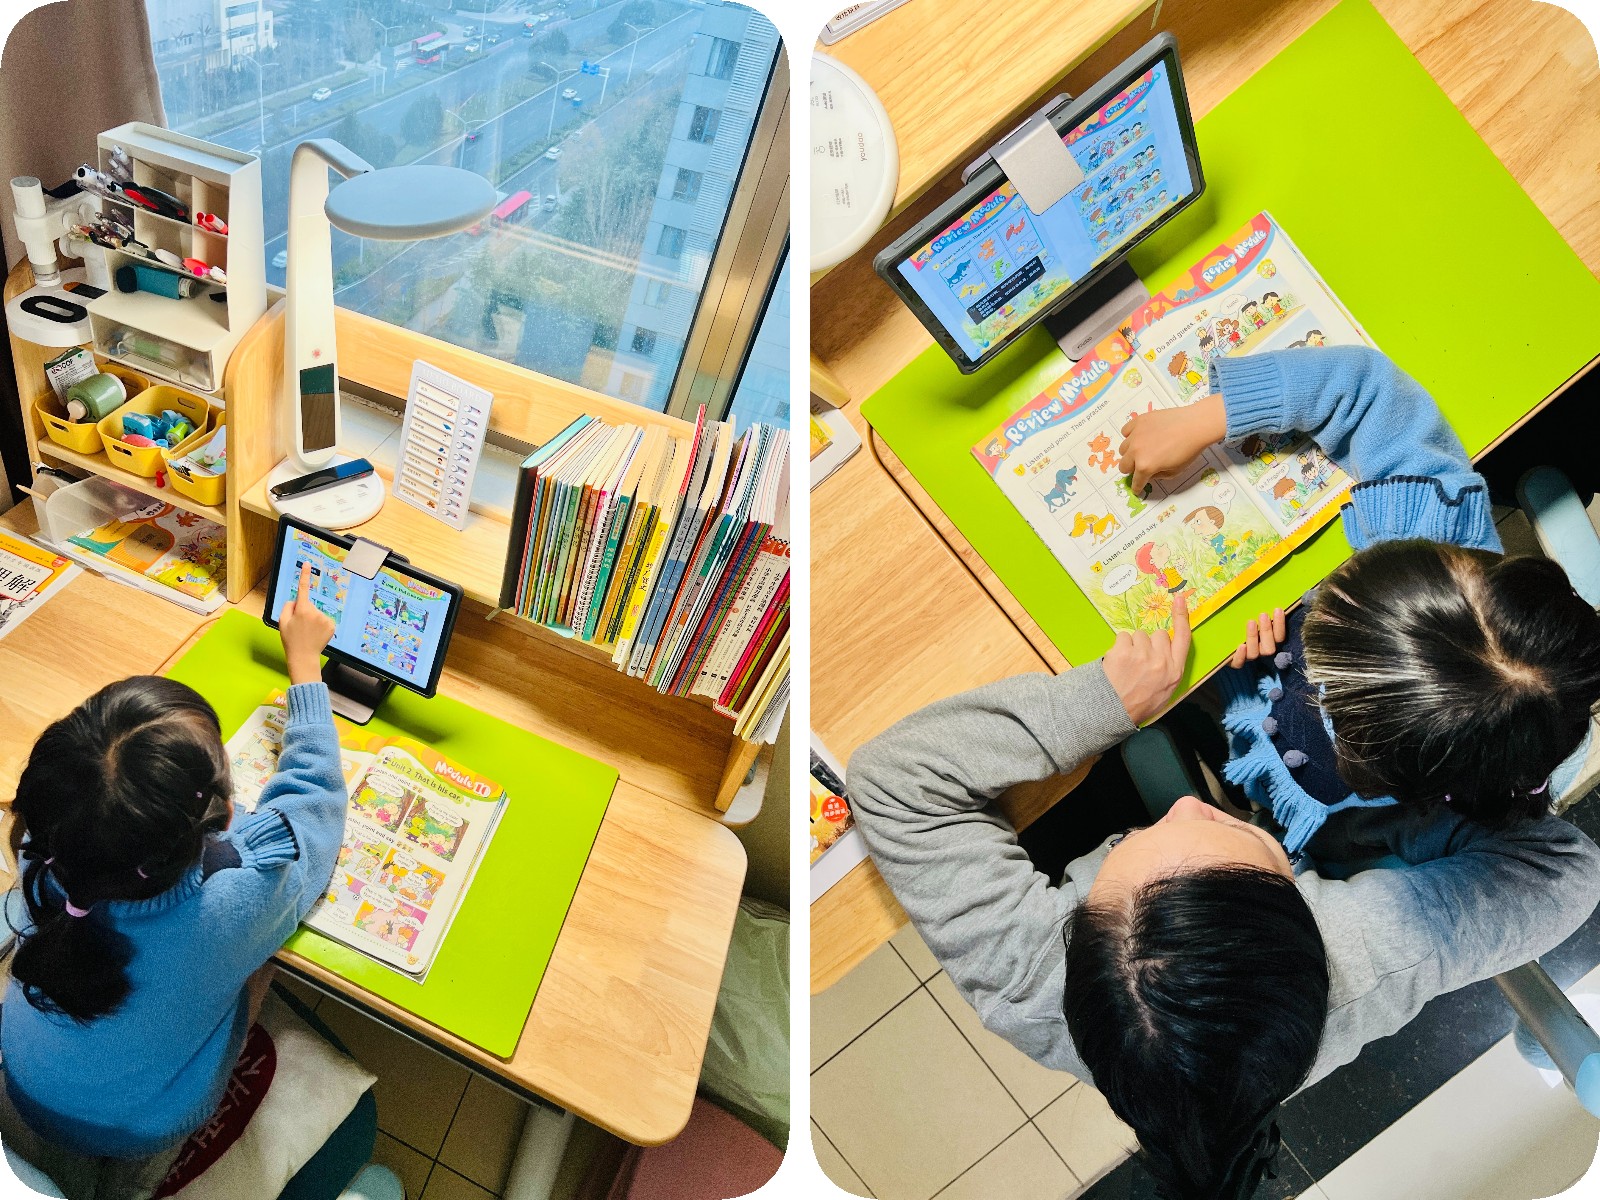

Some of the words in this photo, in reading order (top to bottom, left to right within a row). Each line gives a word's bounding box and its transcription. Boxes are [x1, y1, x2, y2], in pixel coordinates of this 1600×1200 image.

[858, 132, 868, 162] youdao
[931, 221, 973, 254] Review
[970, 194, 1007, 225] Module
[1202, 255, 1237, 284] Review
[1233, 229, 1267, 258] Module
[1155, 343, 1166, 353] Do
[1163, 334, 1177, 346] and
[1004, 397, 1064, 446] Review
[1057, 358, 1111, 405] Module
[1024, 451, 1045, 468] Listen
[1041, 441, 1055, 454] and
[1053, 429, 1073, 446] point.
[1069, 417, 1087, 432] Then
[1083, 398, 1113, 422] practise.
[1101, 548, 1124, 566] Listen,
[1120, 538, 1136, 551] clap
[1132, 529, 1146, 541] and
[1144, 521, 1158, 532] say.
[390, 760, 406, 773] Unit
[414, 772, 430, 786] That
[430, 780, 437, 789] is
[437, 783, 449, 795] his
[448, 789, 461, 802] car.
[434, 760, 473, 789] Module
